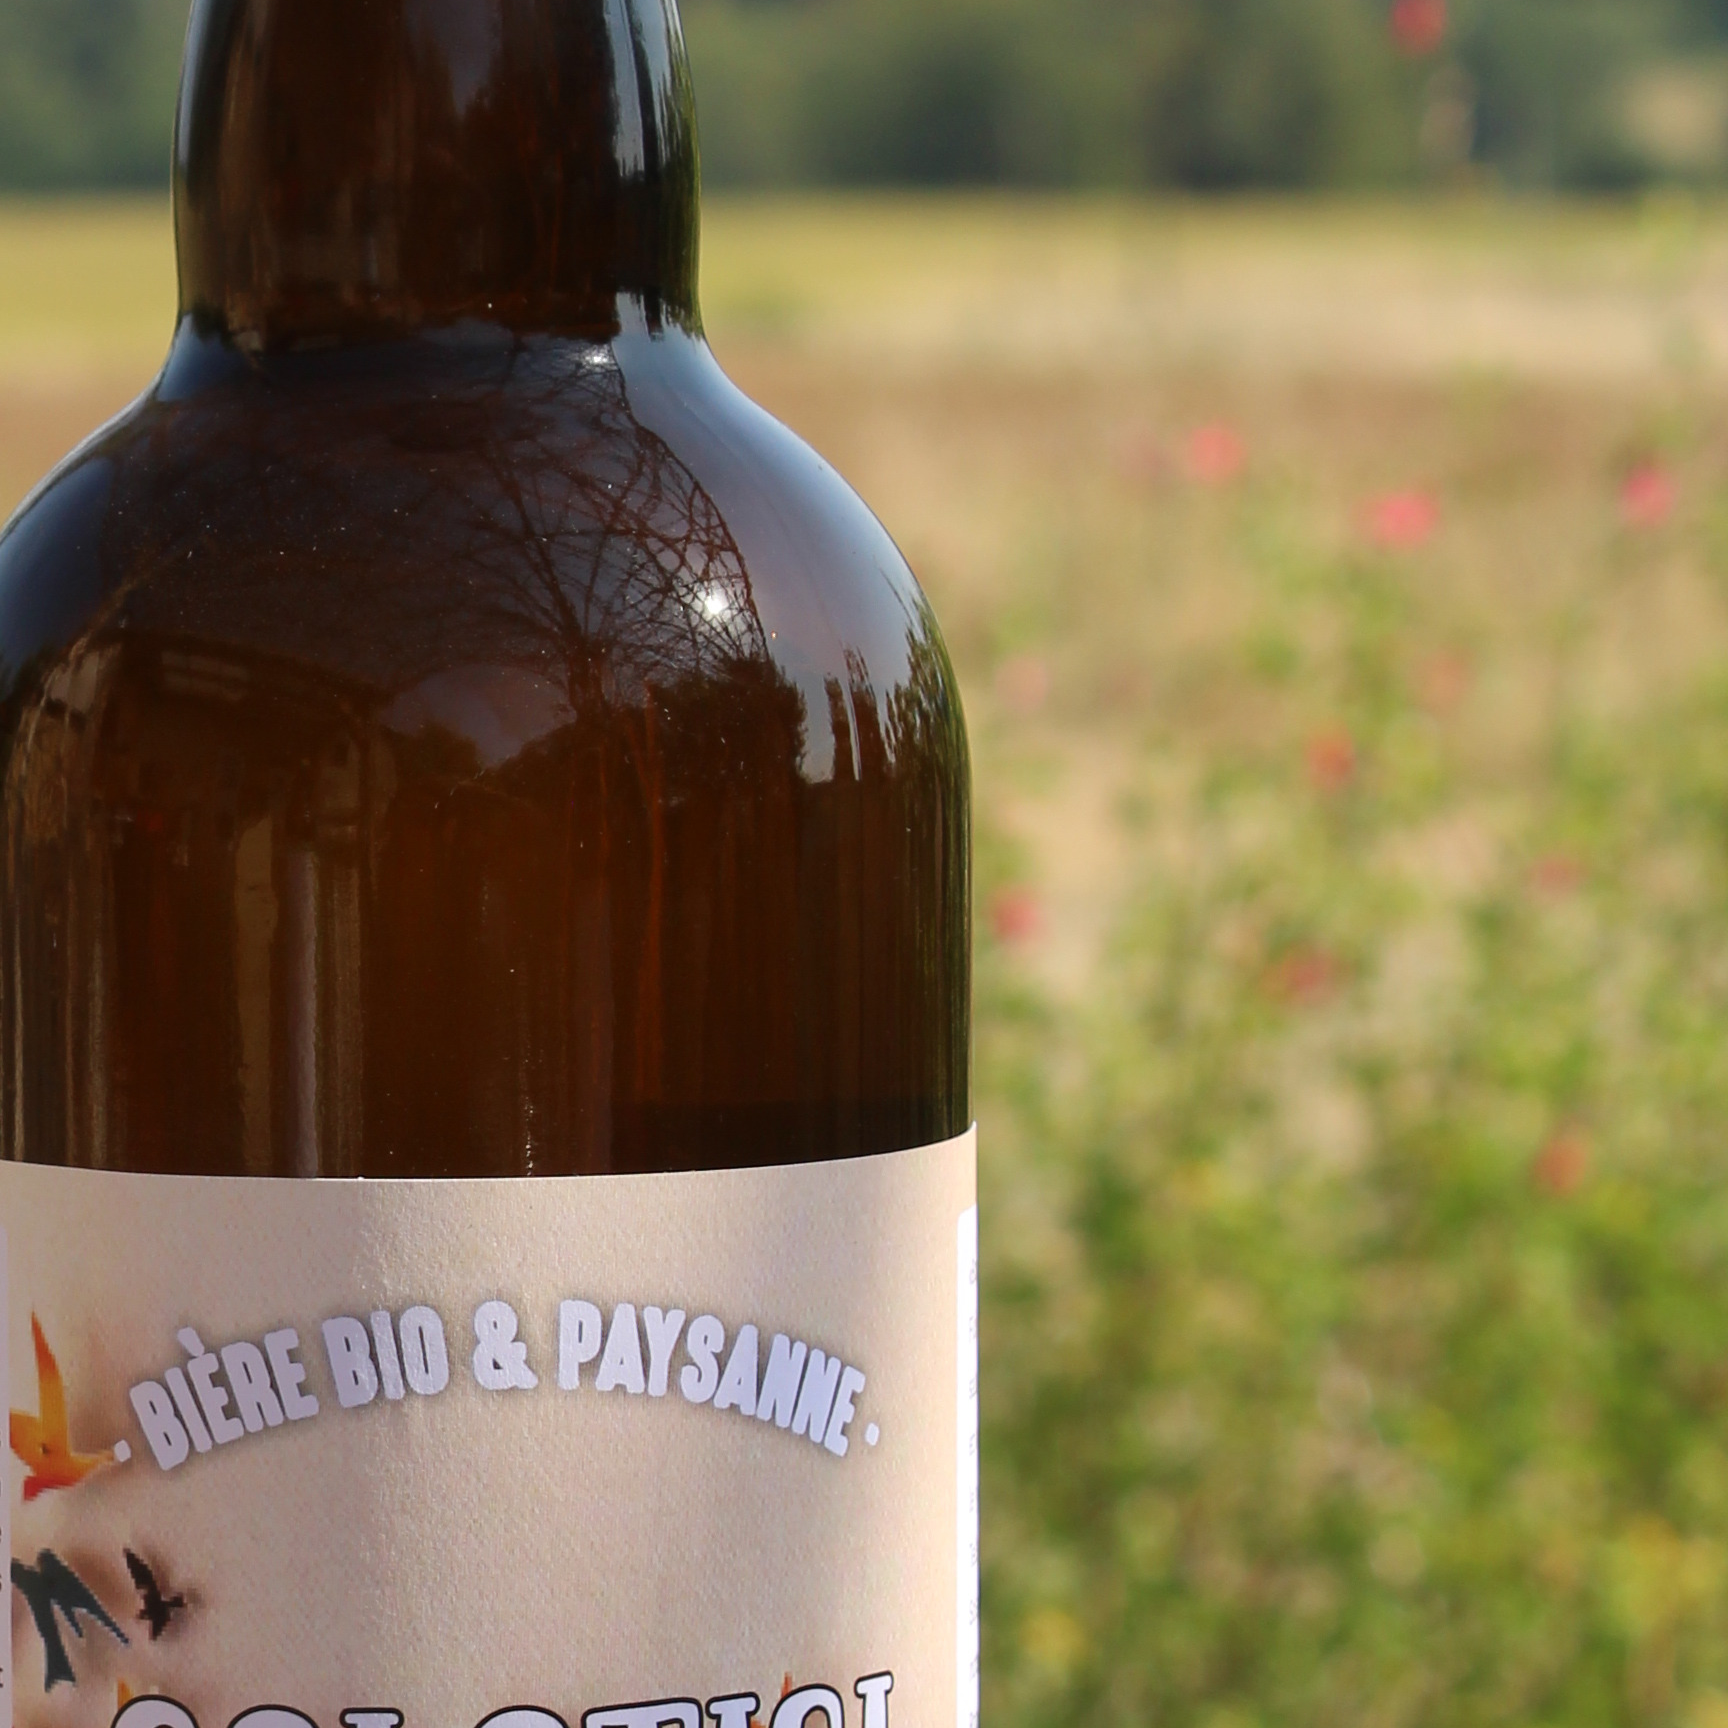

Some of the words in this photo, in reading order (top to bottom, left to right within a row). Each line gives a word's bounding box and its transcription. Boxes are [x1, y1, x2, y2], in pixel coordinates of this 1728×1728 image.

[130, 1326, 320, 1471] BIÈRE
[322, 1305, 450, 1408] BIO
[473, 1299, 539, 1391] &
[558, 1299, 867, 1458] PAYSANNE
